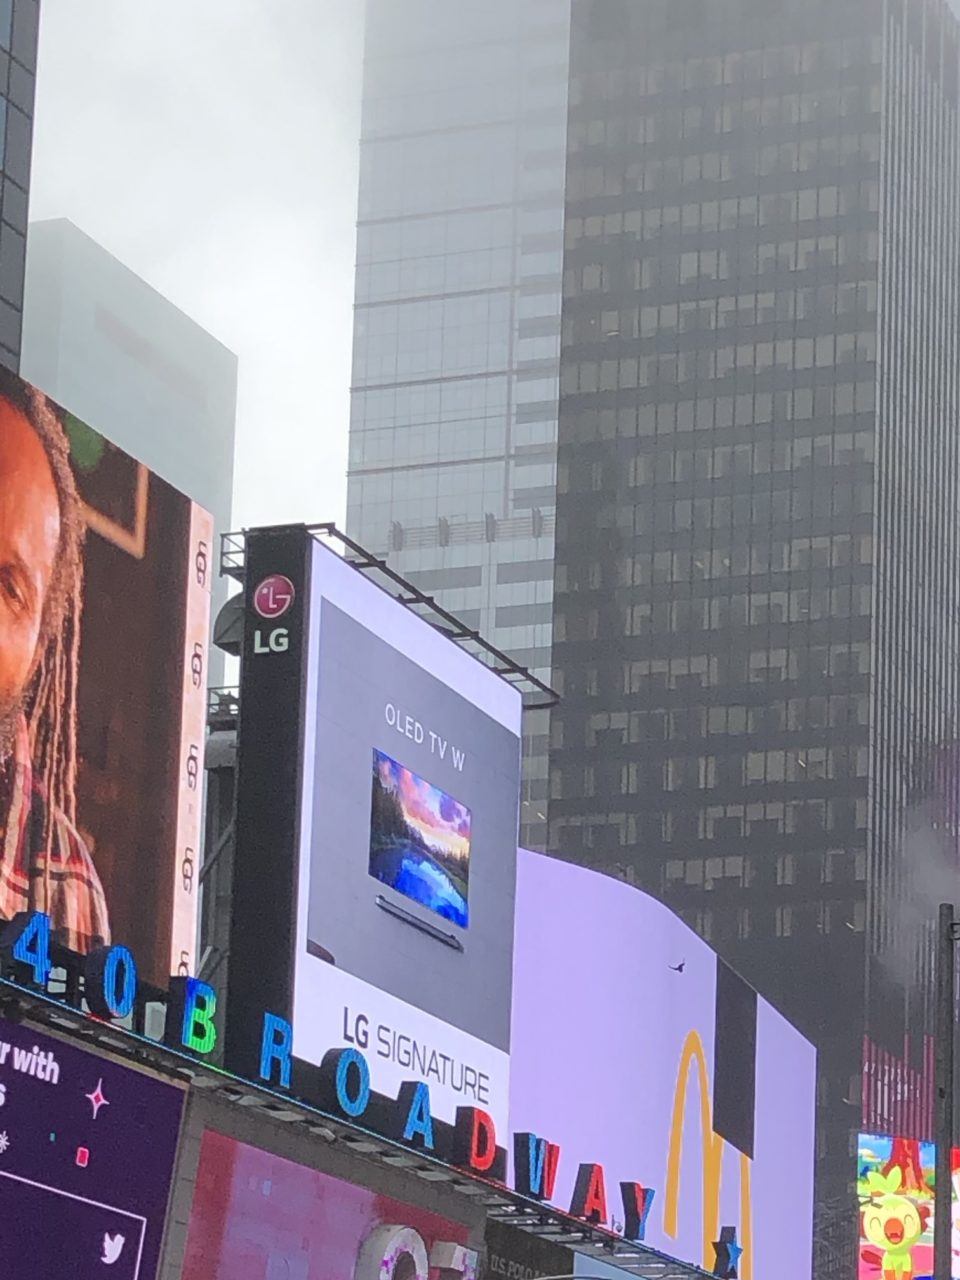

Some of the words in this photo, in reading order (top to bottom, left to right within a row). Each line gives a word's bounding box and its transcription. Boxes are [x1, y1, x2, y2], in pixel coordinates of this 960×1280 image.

[254, 628, 289, 653] LG
[385, 703, 424, 744] OLED
[428, 731, 448, 759] TV
[452, 752, 465, 772] W
[13, 1045, 60, 1085] with
[342, 1006, 370, 1047] LG
[376, 1026, 490, 1105] SIGNATURE
